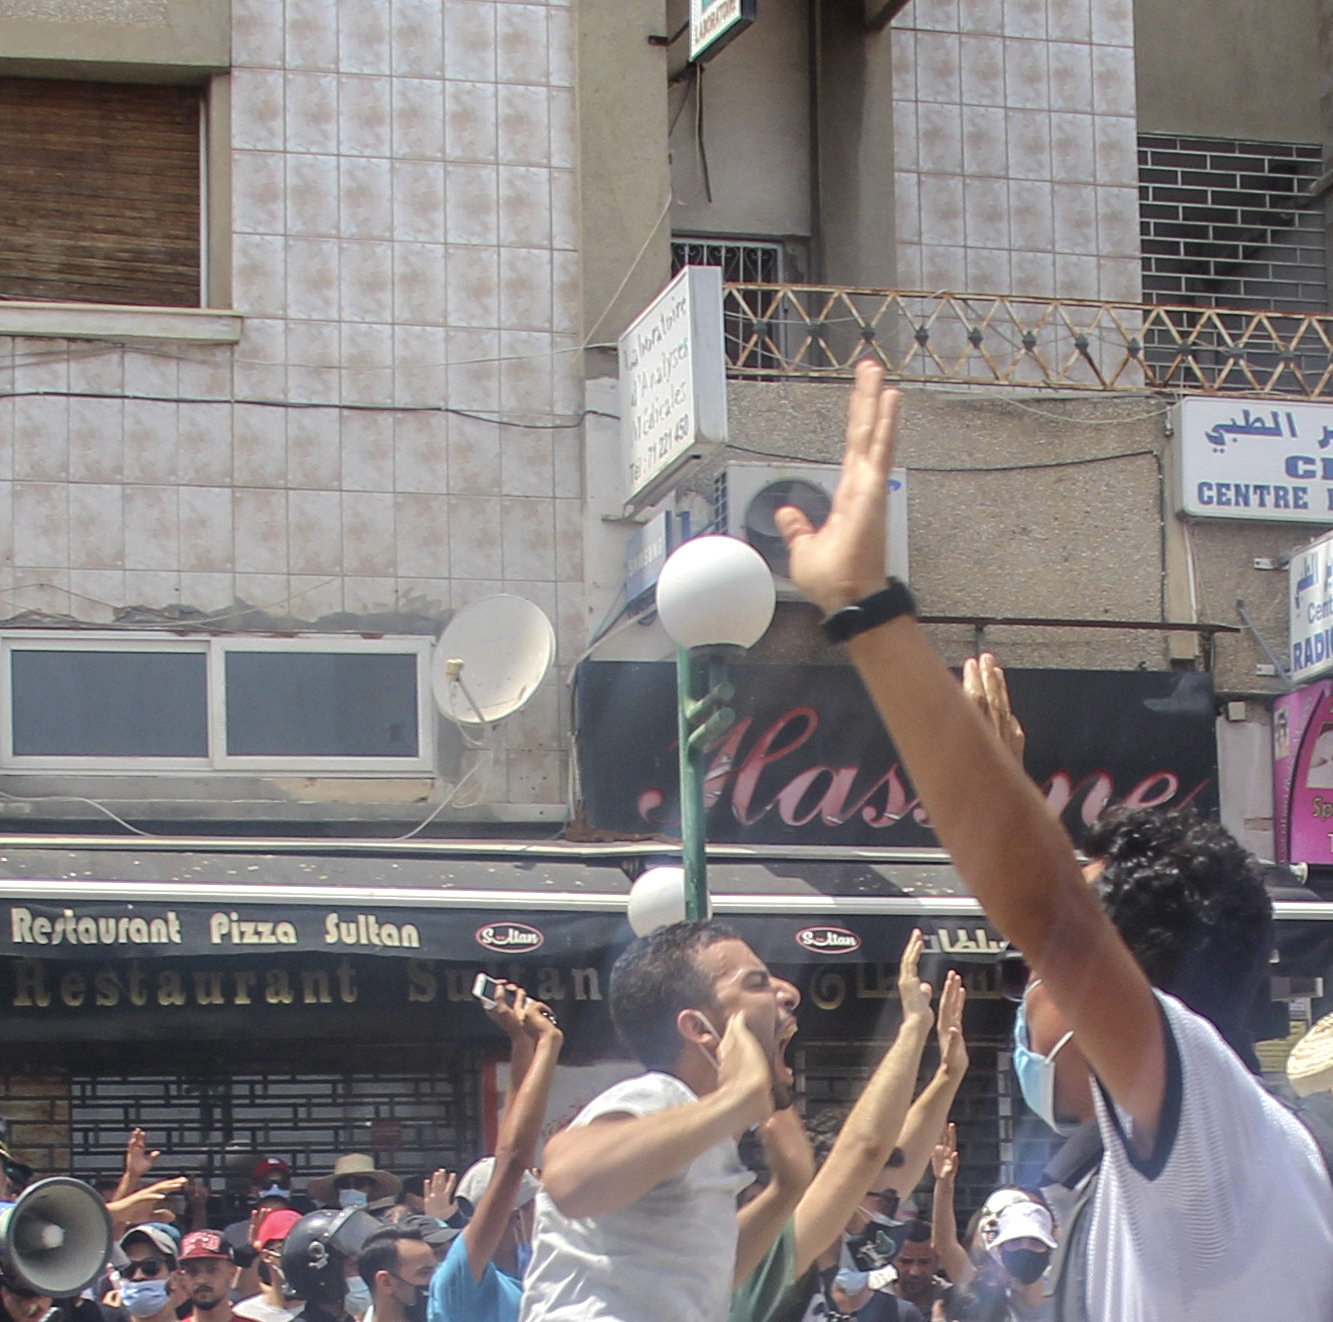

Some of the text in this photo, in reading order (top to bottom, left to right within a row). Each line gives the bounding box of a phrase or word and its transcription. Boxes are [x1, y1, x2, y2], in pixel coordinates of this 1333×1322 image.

[1205, 409, 1298, 453] الطبي
[1197, 481, 1309, 511] CENTRE
[10, 907, 421, 949] Restaurant Pizza Sultan
[12, 957, 603, 1007] Restaurant Suan
